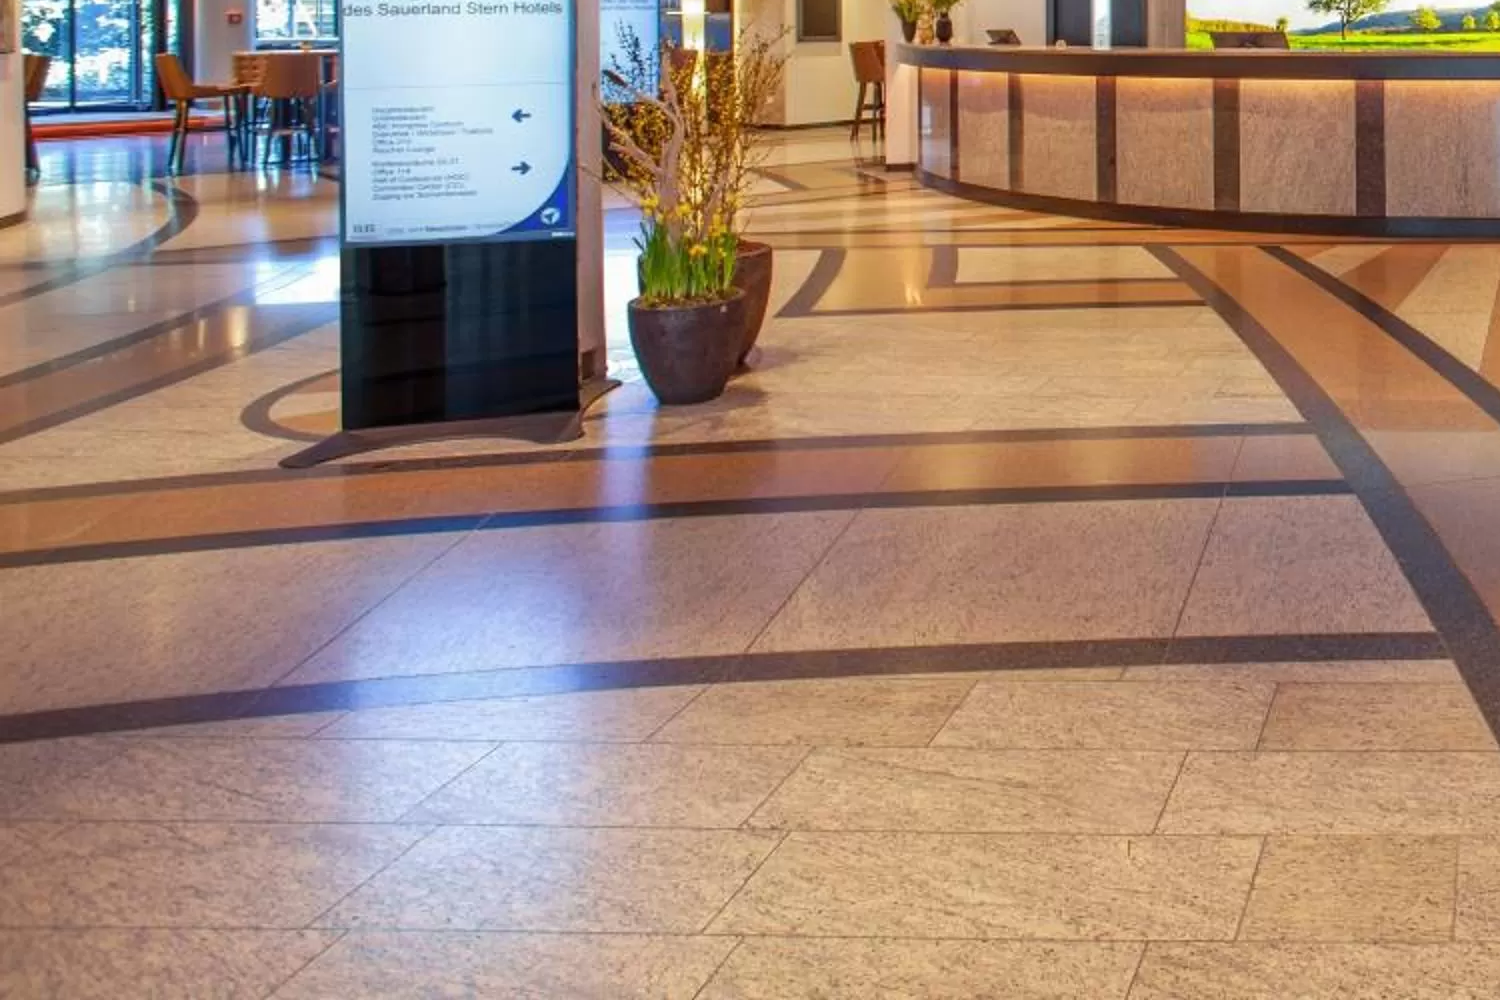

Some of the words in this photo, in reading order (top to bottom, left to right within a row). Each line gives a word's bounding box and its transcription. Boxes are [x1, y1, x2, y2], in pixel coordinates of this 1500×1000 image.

[342, 3, 373, 17] des
[377, 2, 461, 17] Sauerland
[466, 1, 509, 16] Stern
[513, 1, 563, 15] Hotels
